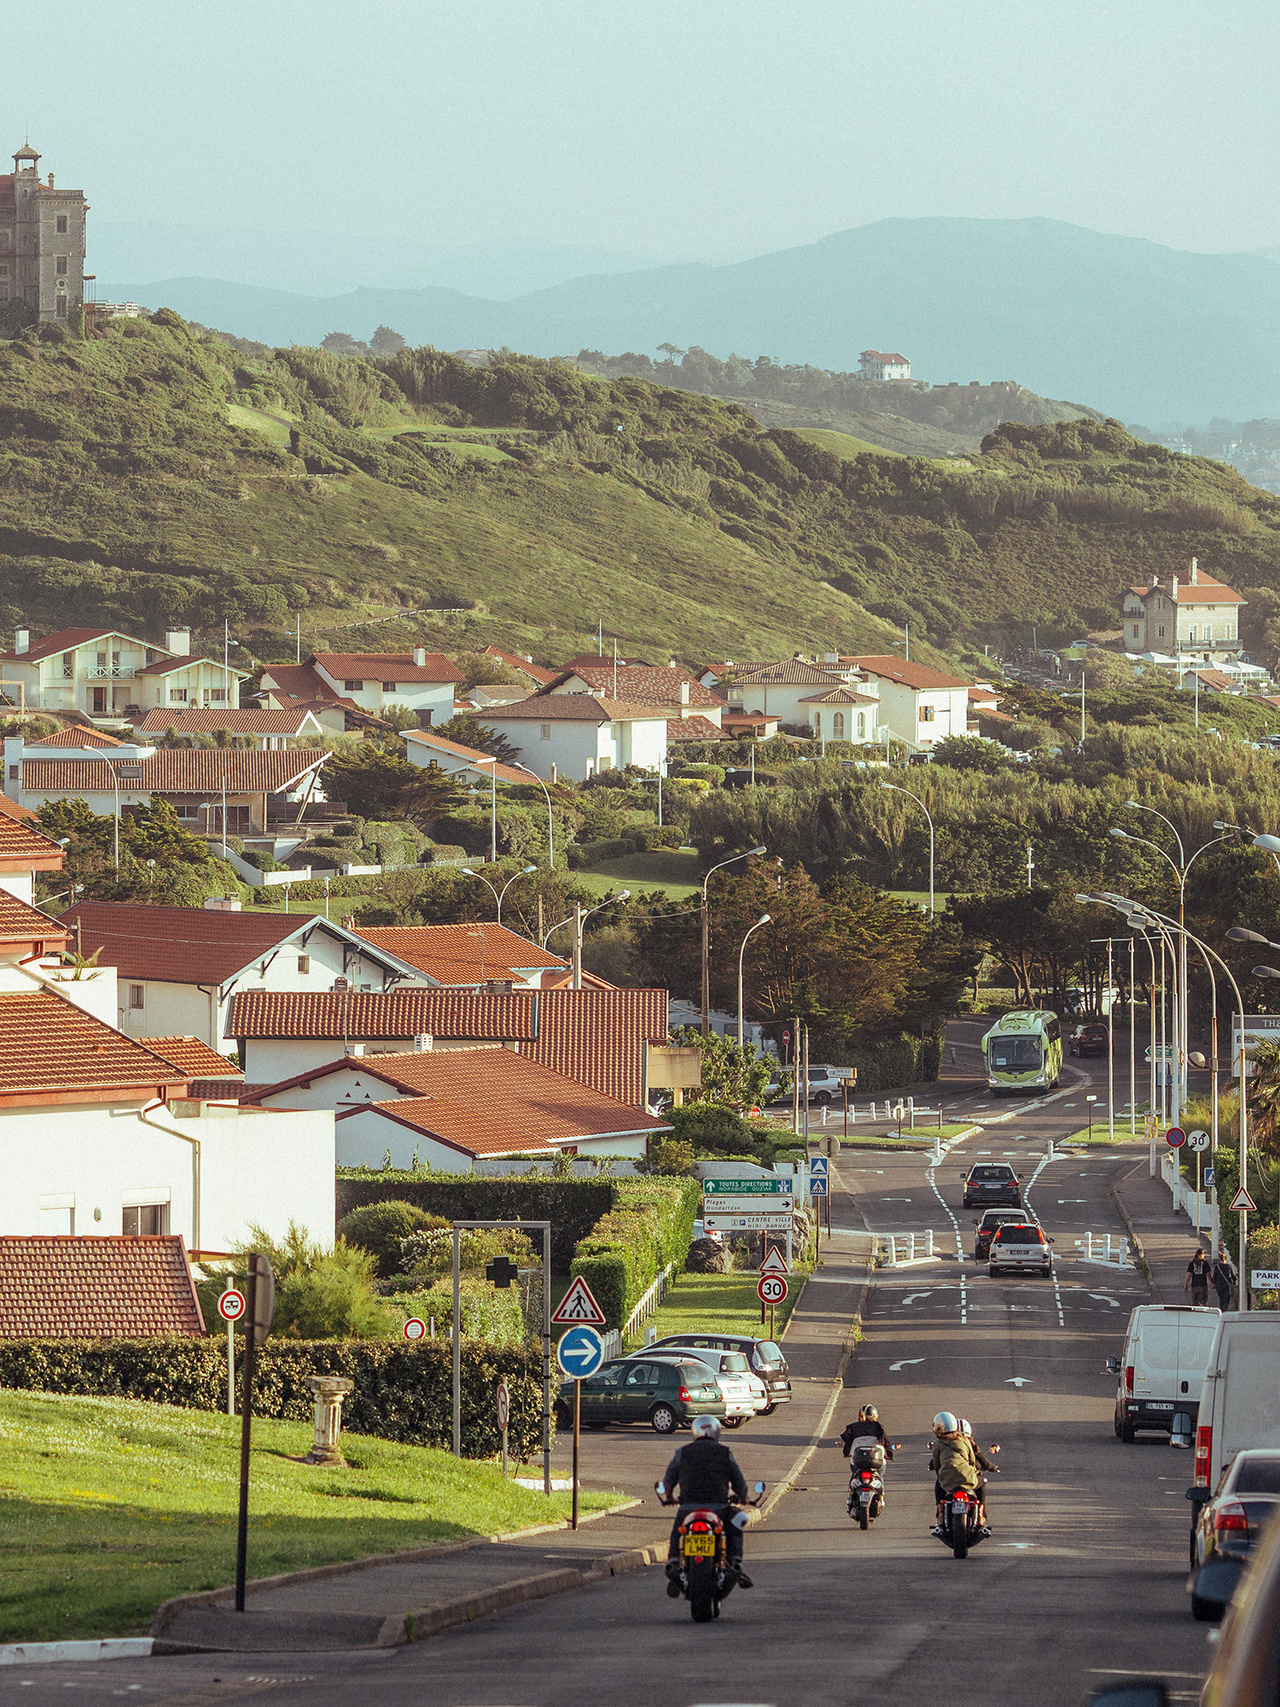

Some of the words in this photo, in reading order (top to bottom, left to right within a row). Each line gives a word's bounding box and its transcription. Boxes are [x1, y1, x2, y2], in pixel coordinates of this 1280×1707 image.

[1192, 1136, 1205, 1146] 30
[763, 1282, 782, 1296] 30
[686, 1536, 714, 1545] KV65
[689, 1545, 710, 1554] LMU
